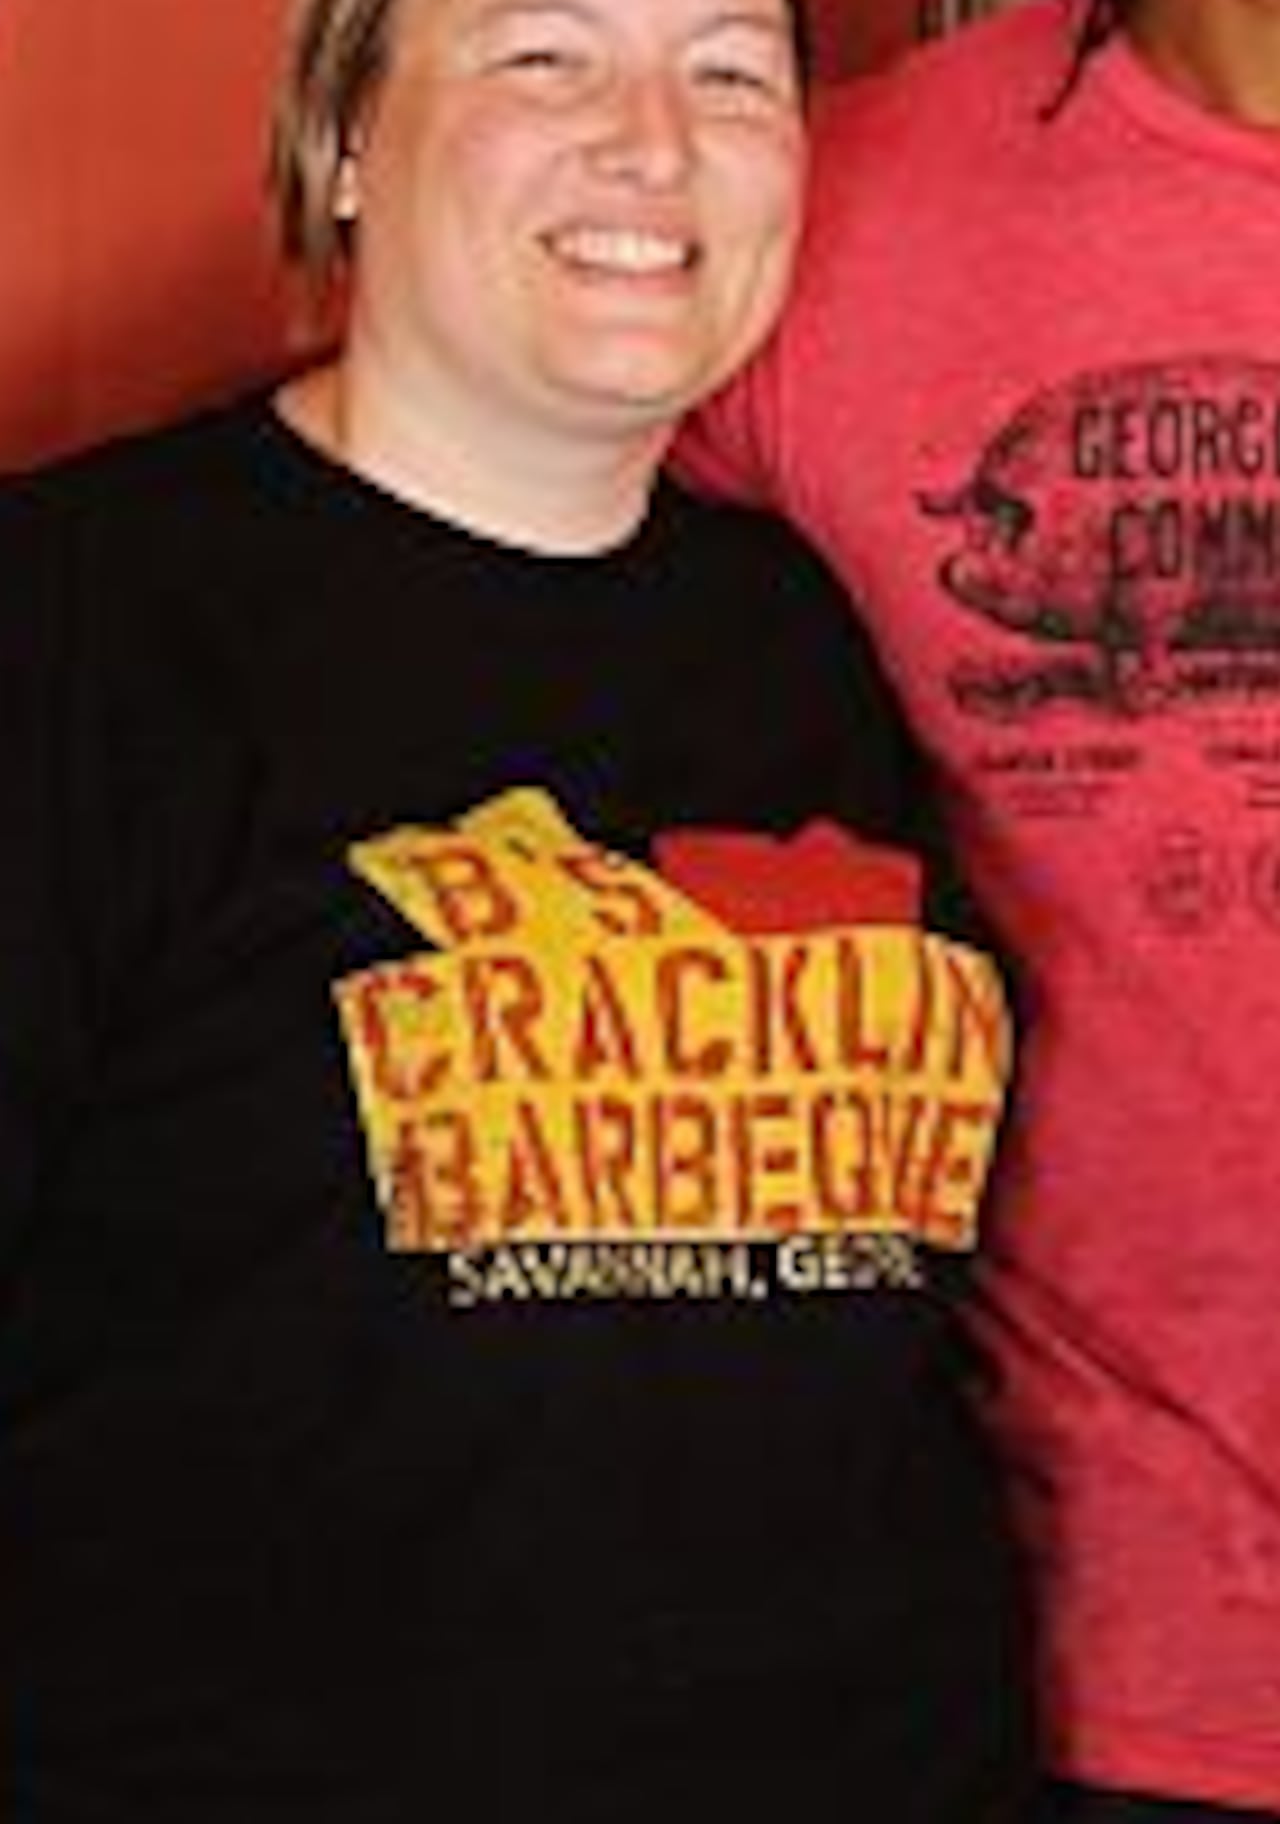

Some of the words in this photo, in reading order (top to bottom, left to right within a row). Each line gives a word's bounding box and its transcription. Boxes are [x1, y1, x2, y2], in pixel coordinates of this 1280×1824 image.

[408, 834, 662, 940] B'S
[360, 938, 1004, 1099] CRACKLIN
[394, 1090, 1002, 1246] BARBEQUE
